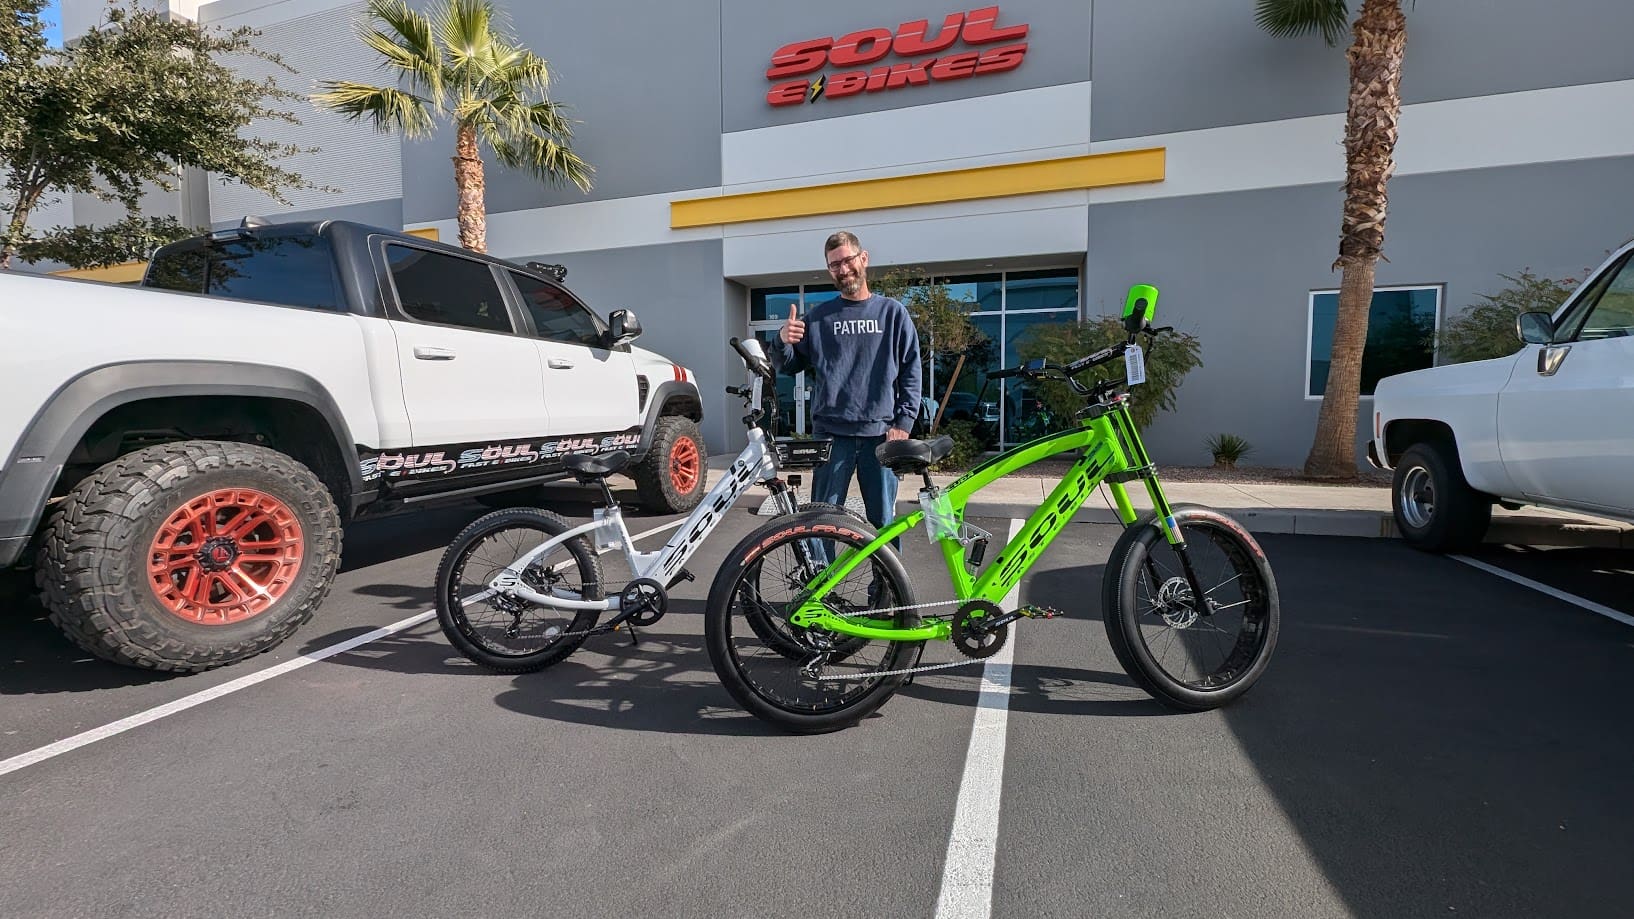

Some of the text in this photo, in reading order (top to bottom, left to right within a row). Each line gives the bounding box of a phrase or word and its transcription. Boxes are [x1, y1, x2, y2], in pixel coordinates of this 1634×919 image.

[766, 5, 1030, 80] SOUL
[825, 42, 1029, 99] BIKES
[833, 319, 883, 335] PATROL
[360, 452, 456, 476] SOUL
[457, 444, 539, 464] SOUL
[539, 438, 600, 455] SOUL
[664, 457, 763, 577] SOUL
[1000, 450, 1115, 587] SOUL
